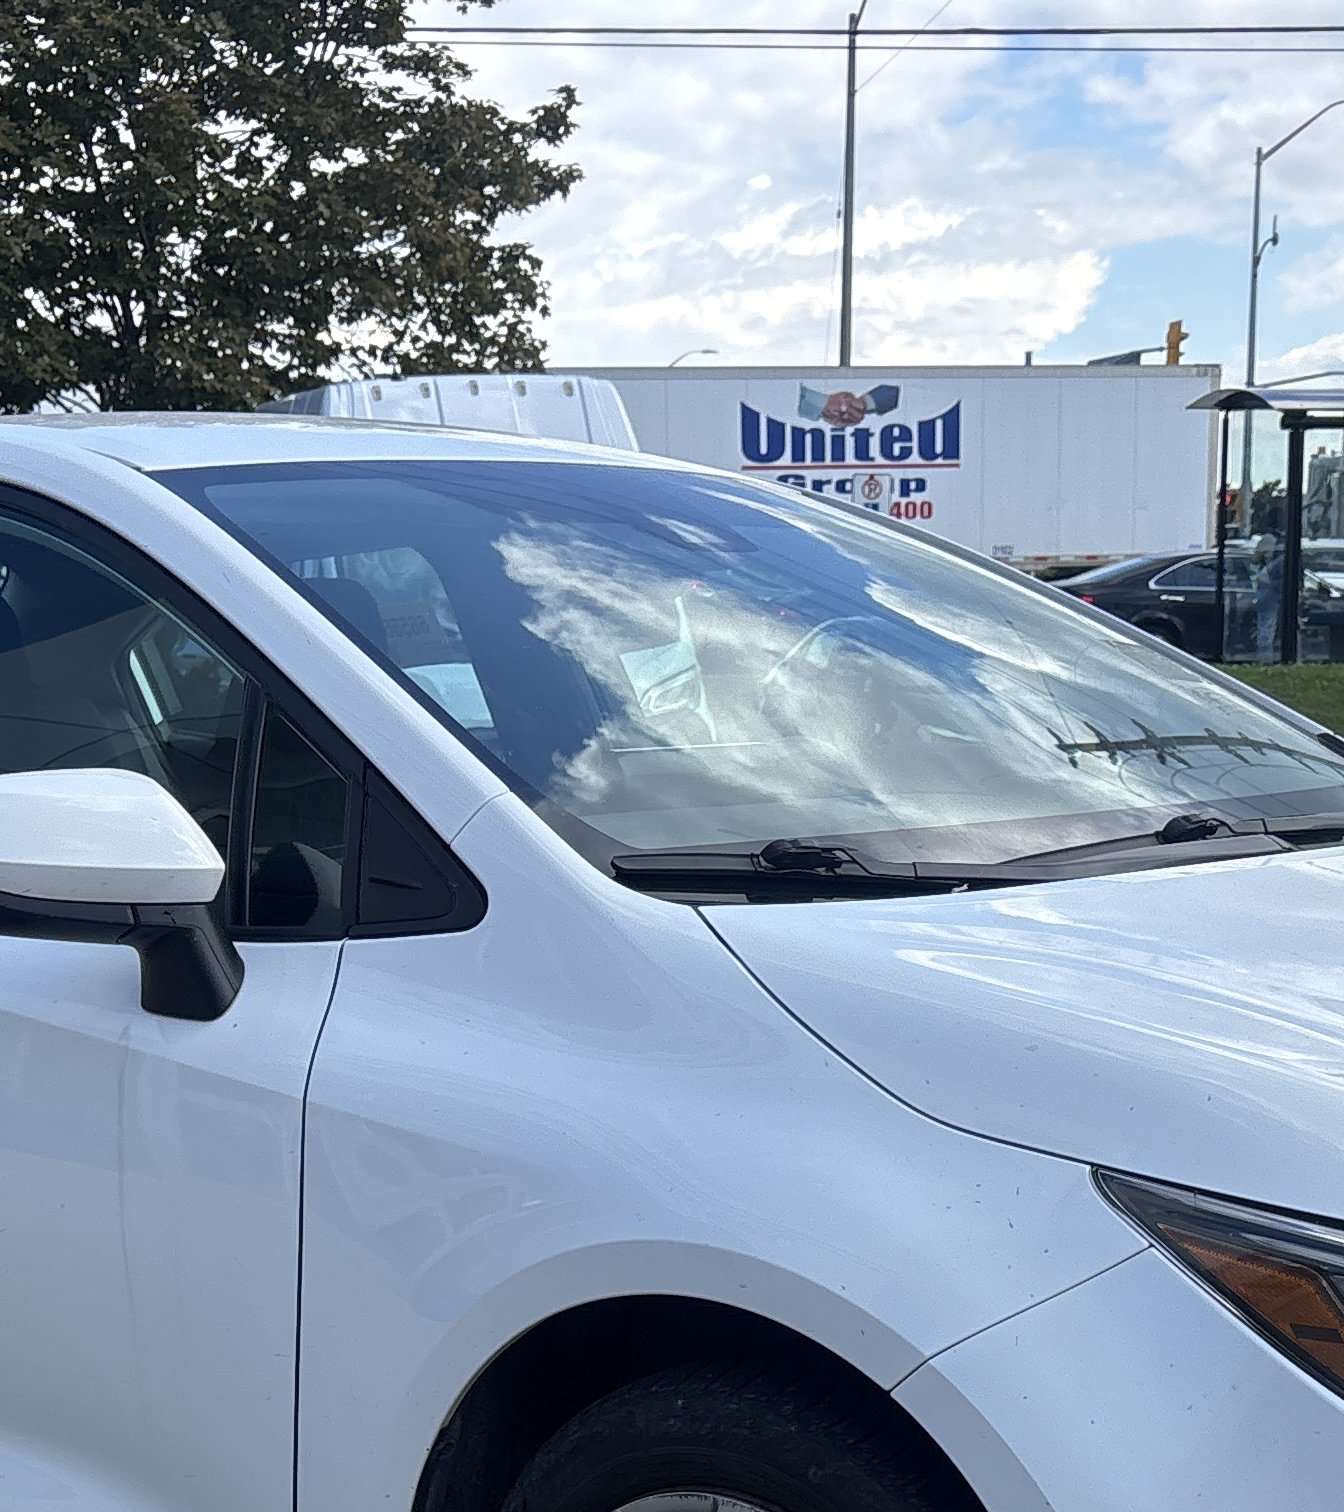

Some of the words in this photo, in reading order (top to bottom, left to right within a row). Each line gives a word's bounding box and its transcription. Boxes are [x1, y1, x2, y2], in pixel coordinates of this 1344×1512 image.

[740, 400, 961, 464] United
[776, 474, 927, 498] Grop
[889, 501, 934, 519] 400
